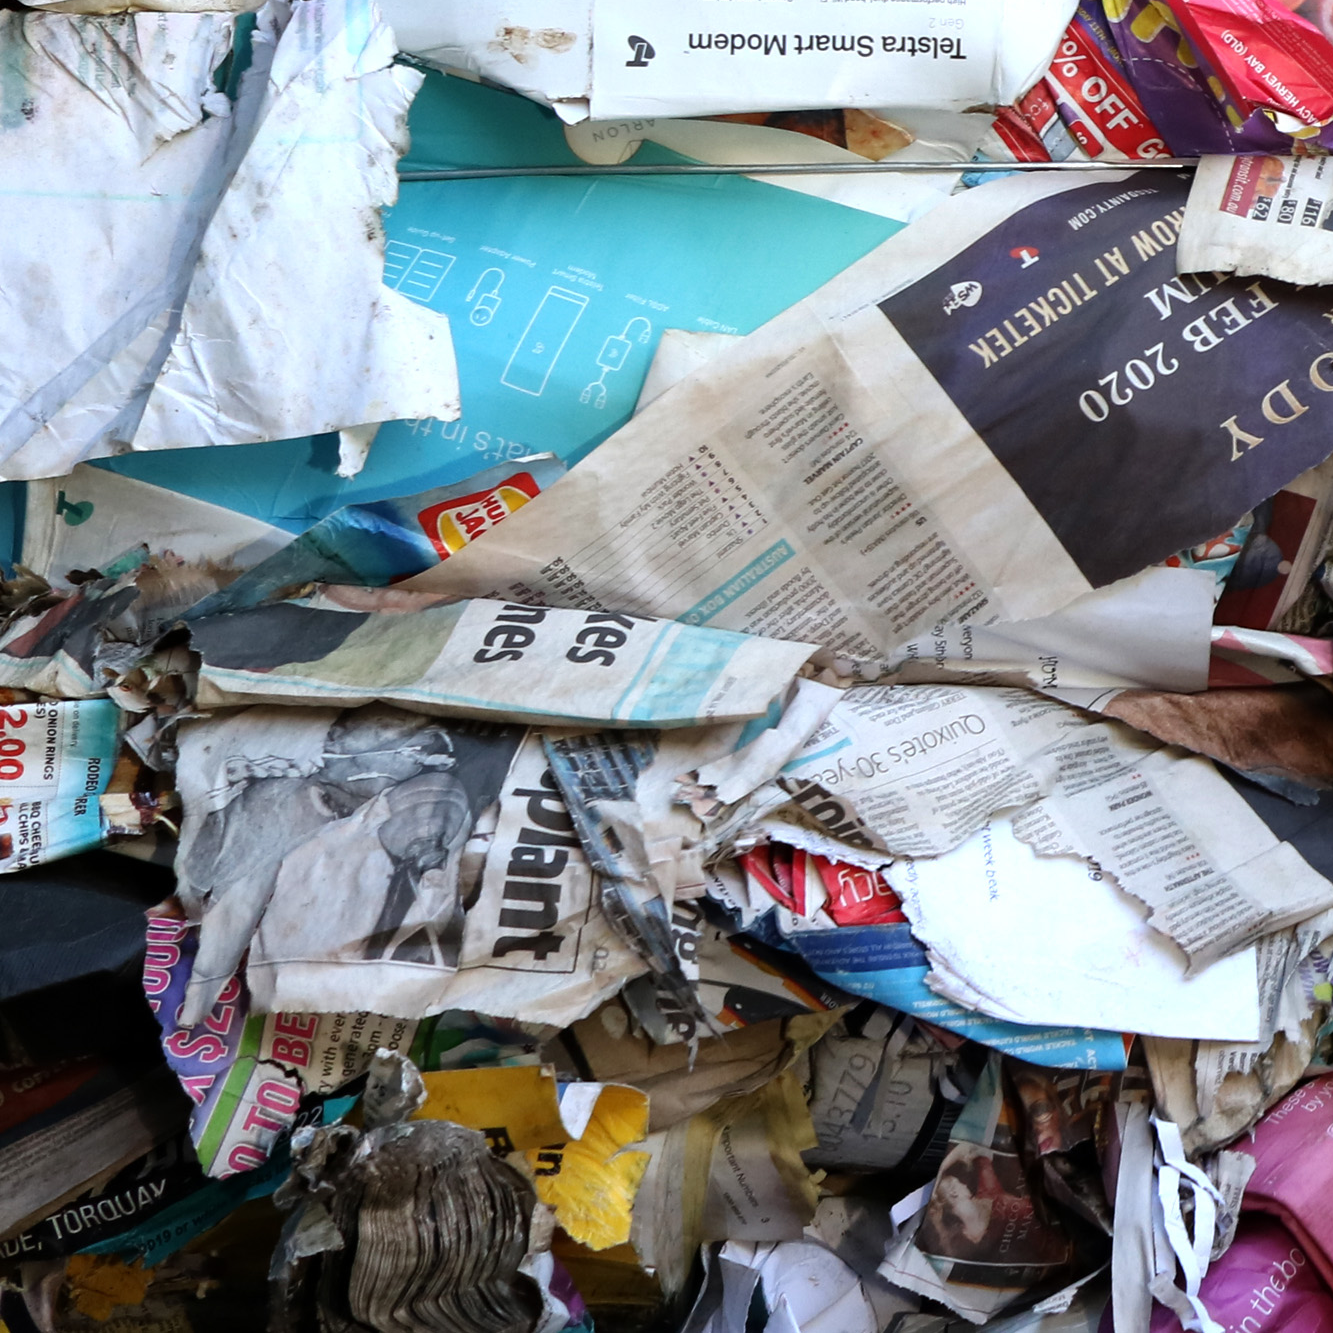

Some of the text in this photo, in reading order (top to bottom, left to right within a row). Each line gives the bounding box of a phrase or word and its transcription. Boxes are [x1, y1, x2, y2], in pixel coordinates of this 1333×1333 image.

[688, 32, 967, 60] Telstra Smart Modem
[942, 17, 965, 30] Gen
[1219, 28, 1300, 112] HERVEY BAY (QLD)
[1081, 75, 1141, 131] OFF
[1093, 246, 1131, 288] AT
[967, 272, 1099, 370] TICKETEK
[1181, 281, 1280, 354] FEB
[1077, 341, 1180, 424] 2020
[724, 543, 791, 601] AUSTRALIAN
[43, 709, 58, 781] ONION RINGS
[892, 712, 986, 765] Quixote's
[85, 757, 102, 792] RODEO
[18, 810, 30, 848] CHIPS
[242, 1079, 301, 1132] TO
[1263, 1089, 1311, 1127] These
[45, 1177, 168, 1241] TORQUAY
[736, 1172, 760, 1209] Numbers
